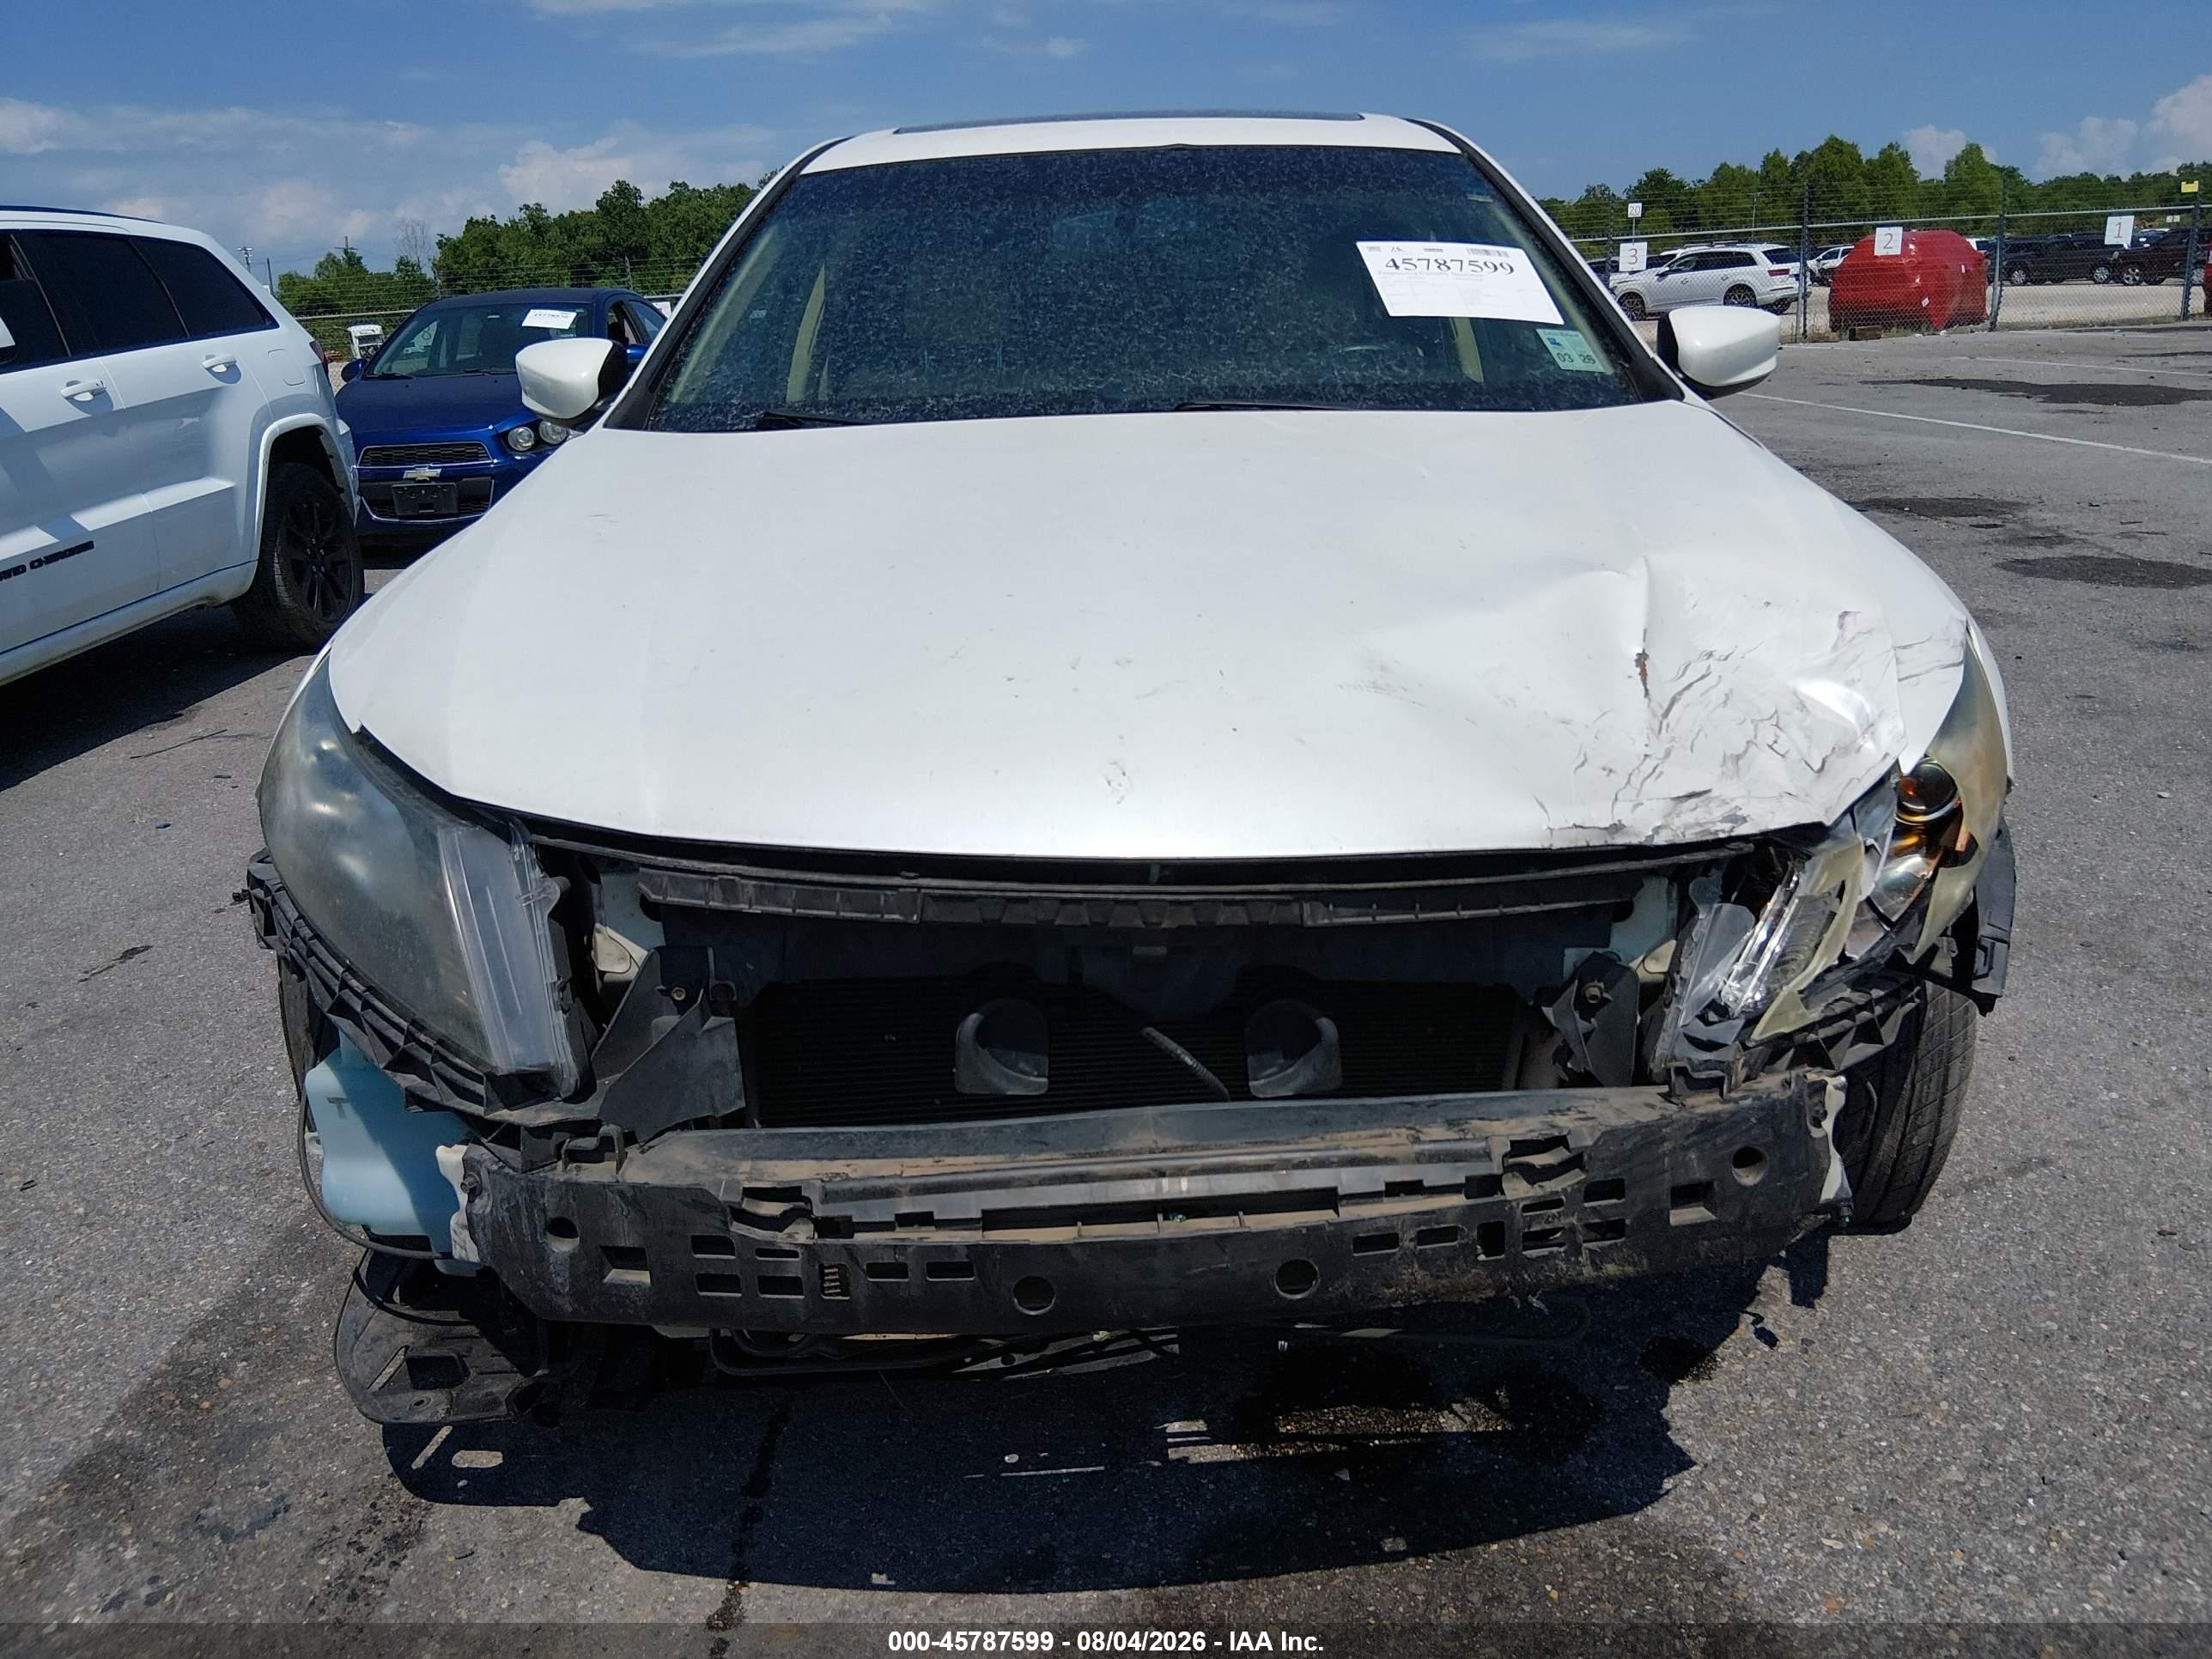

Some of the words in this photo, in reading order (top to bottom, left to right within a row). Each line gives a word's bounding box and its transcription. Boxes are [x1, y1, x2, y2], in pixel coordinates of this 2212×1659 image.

[2113, 222, 2124, 239] 1
[1882, 233, 1894, 250] 2
[1627, 247, 1638, 265] 3
[1384, 257, 1515, 276] 45787599
[1556, 352, 1574, 363] 03
